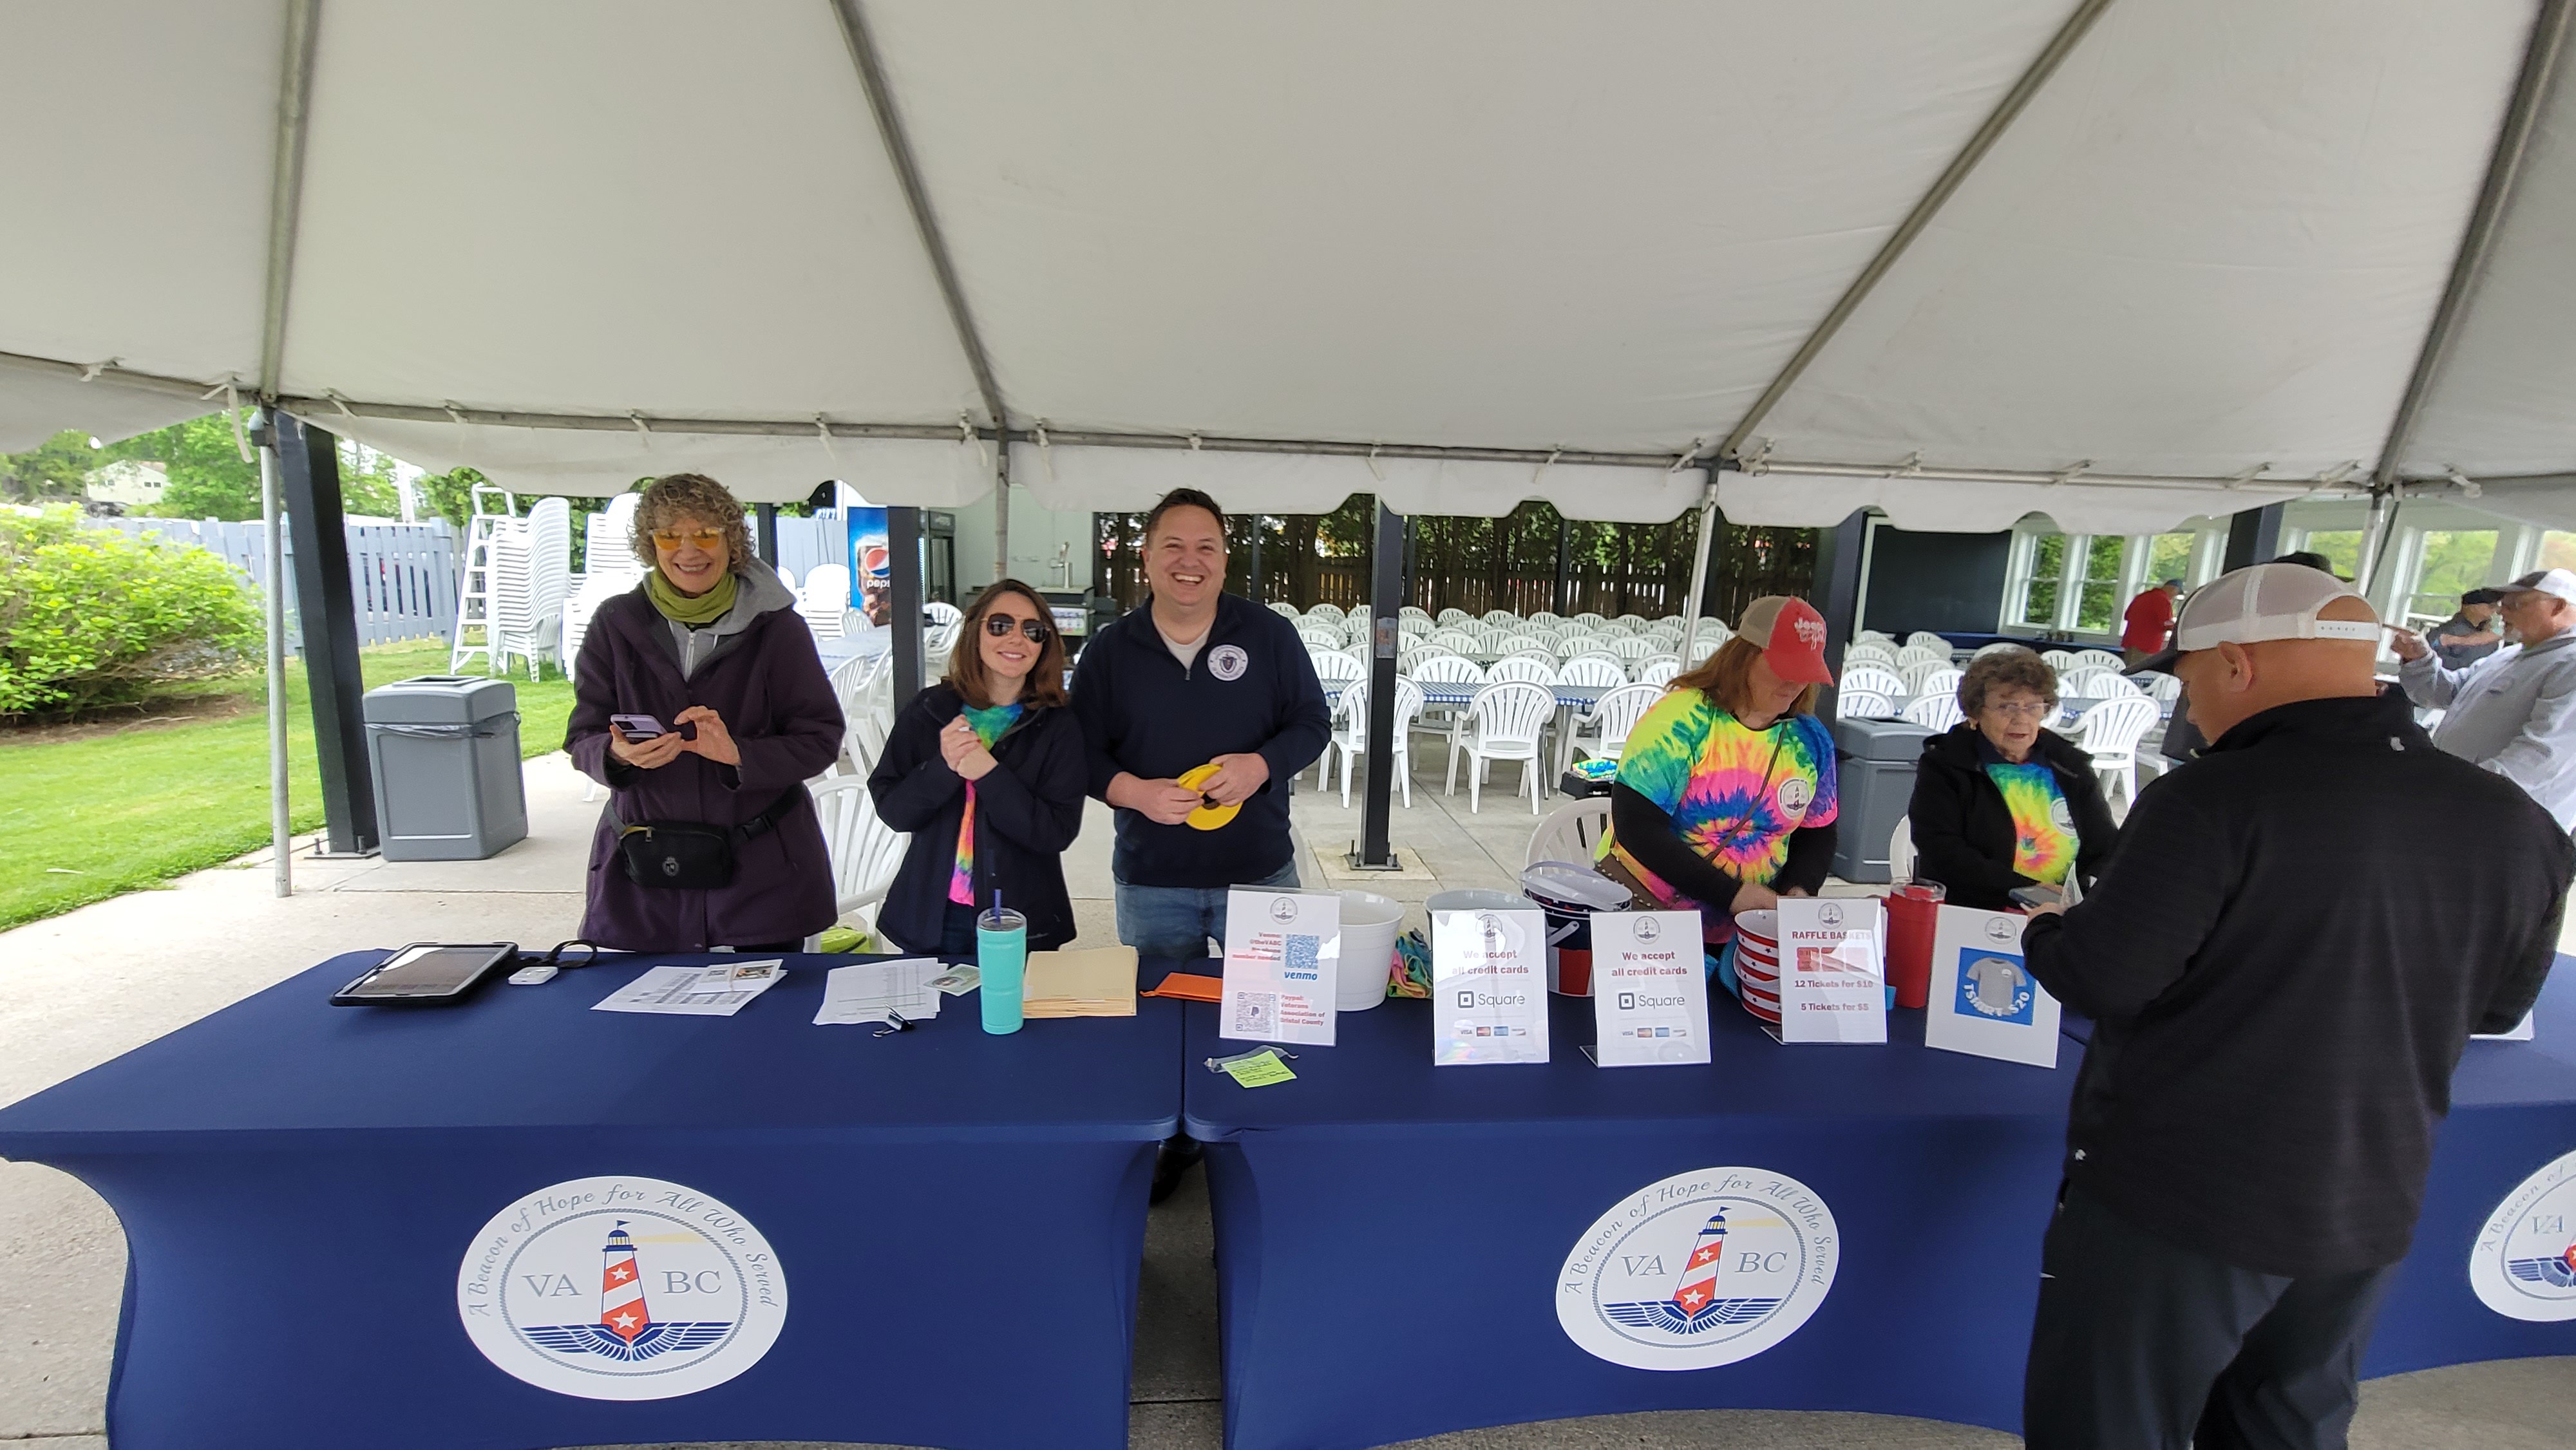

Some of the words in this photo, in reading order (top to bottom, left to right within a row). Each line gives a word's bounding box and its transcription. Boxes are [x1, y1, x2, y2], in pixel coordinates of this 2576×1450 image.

[1792, 931, 1827, 939] RAFFLE
[1830, 931, 1872, 939] BASKETS
[1482, 950, 1517, 959] accept
[1641, 951, 1676, 961] accept
[1284, 971, 1318, 981] venmo
[1452, 966, 1465, 975] all
[1467, 965, 1498, 974] credit
[1500, 965, 1530, 974] cards
[1611, 968, 1624, 976] all
[1627, 967, 1657, 975] credit
[1659, 966, 1687, 975] cards
[1478, 993, 1525, 1008] Square
[1639, 995, 1685, 1009] Square
[1857, 1003, 1869, 1011] $5
[1964, 983, 2003, 1017] TSHIRT
[2008, 992, 2031, 1014] $20
[1656, 1181, 1712, 1202] Hope
[1714, 1174, 1754, 1192] for
[1758, 1181, 1795, 1201] All
[533, 1191, 596, 1218] Hope
[601, 1183, 647, 1206] for
[655, 1190, 705, 1215] All
[1629, 1195, 1651, 1218] of
[1792, 1196, 1824, 1231] Who
[510, 1207, 533, 1233] of
[702, 1207, 747, 1248] Who
[2480, 1239, 2496, 1252] A
[2488, 1185, 2539, 1234] Beacon
[2532, 1214, 2563, 1234] VA
[1569, 1219, 1623, 1275] Beacon
[468, 1234, 509, 1297] Beacon
[1621, 1254, 1667, 1276] VA
[1734, 1251, 1788, 1274] BC
[1810, 1236, 1832, 1286] Served
[522, 1274, 582, 1298] VA
[660, 1270, 722, 1295] BC
[744, 1252, 779, 1308] Served
[1564, 1281, 1583, 1294] A
[468, 1304, 491, 1317] A
